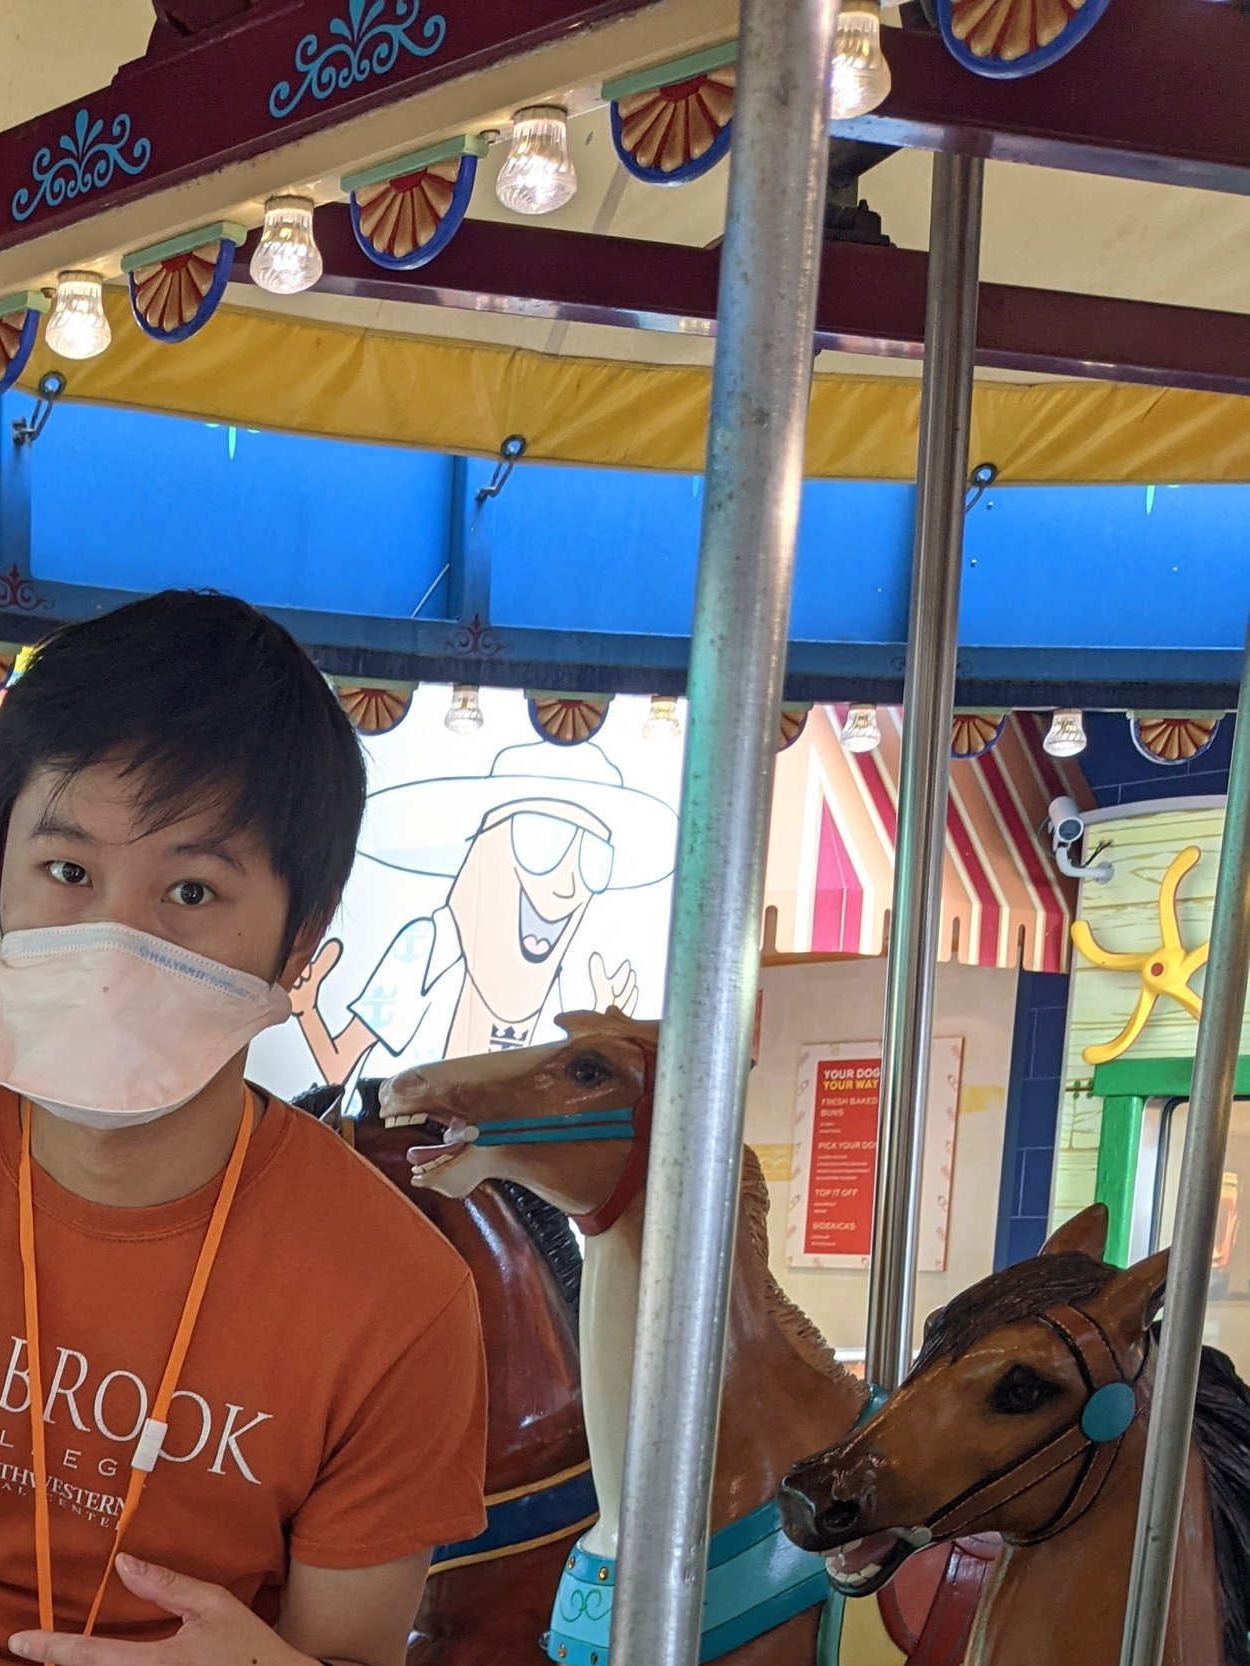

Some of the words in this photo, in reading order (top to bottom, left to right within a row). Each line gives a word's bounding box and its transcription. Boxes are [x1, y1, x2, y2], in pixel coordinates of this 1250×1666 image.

[823, 1069, 855, 1080] YOUR
[856, 1067, 881, 1078] DOG
[822, 1080, 854, 1091] YOUR
[855, 1079, 880, 1089] WAY
